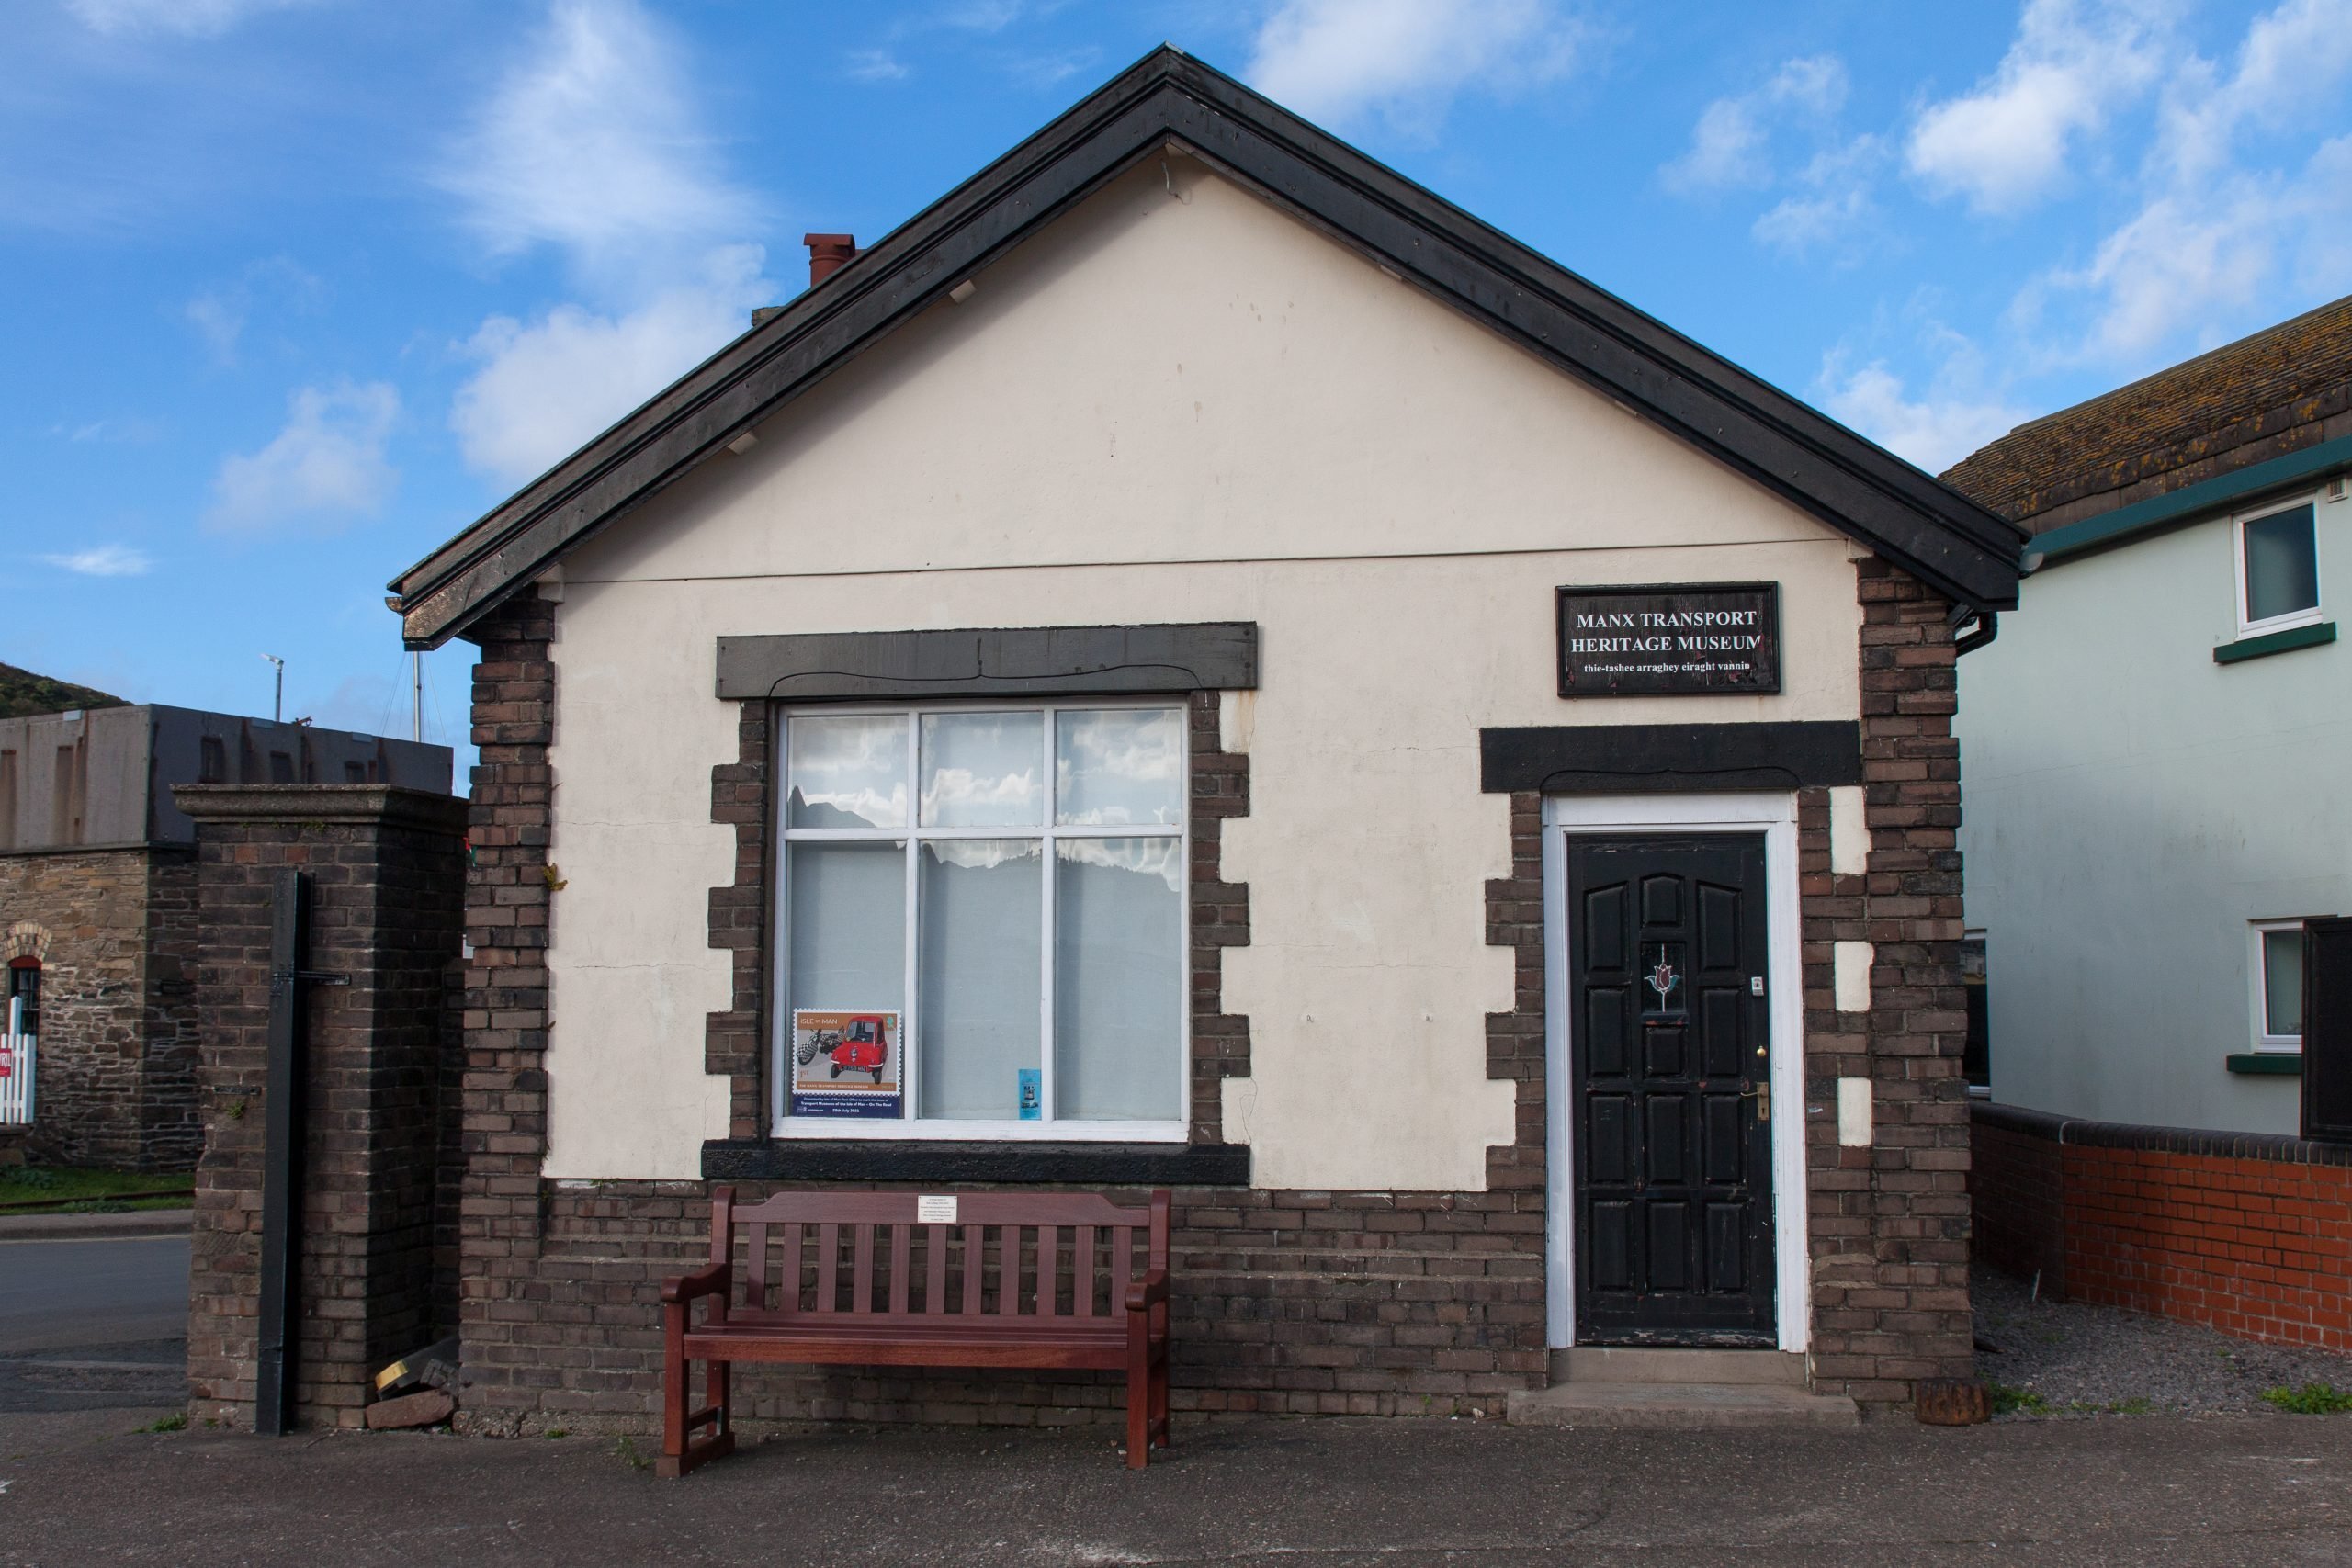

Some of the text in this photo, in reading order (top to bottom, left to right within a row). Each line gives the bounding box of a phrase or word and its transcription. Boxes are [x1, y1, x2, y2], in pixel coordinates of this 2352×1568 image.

[1577, 610, 1757, 628] MANX TRANSPORT
[1571, 635, 1761, 652] HERITAGE MUSEUM
[1584, 664, 1634, 672] thie-tashee
[1636, 662, 1679, 673] arraghey
[1681, 661, 1715, 671] eiraght
